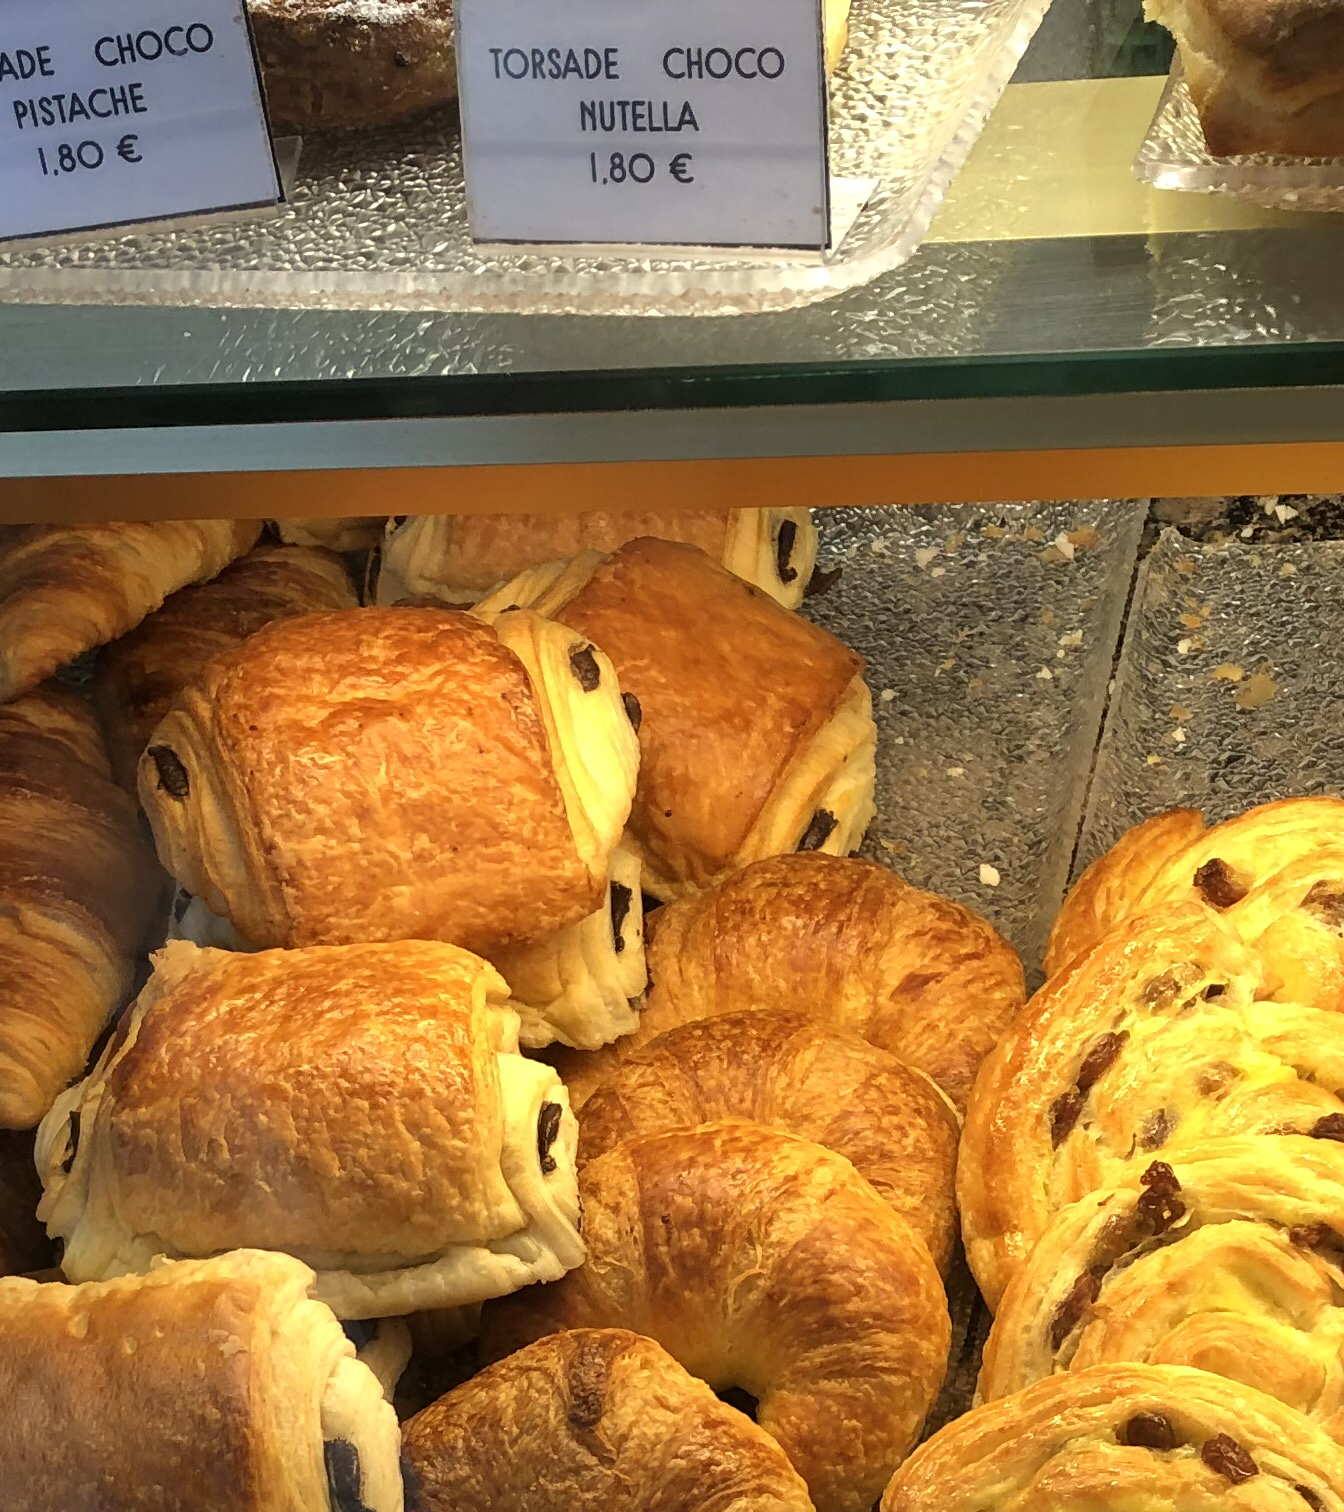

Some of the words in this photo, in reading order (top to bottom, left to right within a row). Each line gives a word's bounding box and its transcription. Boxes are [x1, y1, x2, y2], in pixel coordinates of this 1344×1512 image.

[95, 23, 213, 67] CHOCO
[489, 47, 620, 80] TORSADE
[663, 47, 785, 79] CHOCO
[13, 82, 148, 129] PISTACHE
[580, 100, 699, 132] NUTELLA
[37, 141, 104, 176] 1.80
[116, 134, 143, 163] €
[590, 152, 655, 185] 1.80
[669, 152, 694, 184] €
